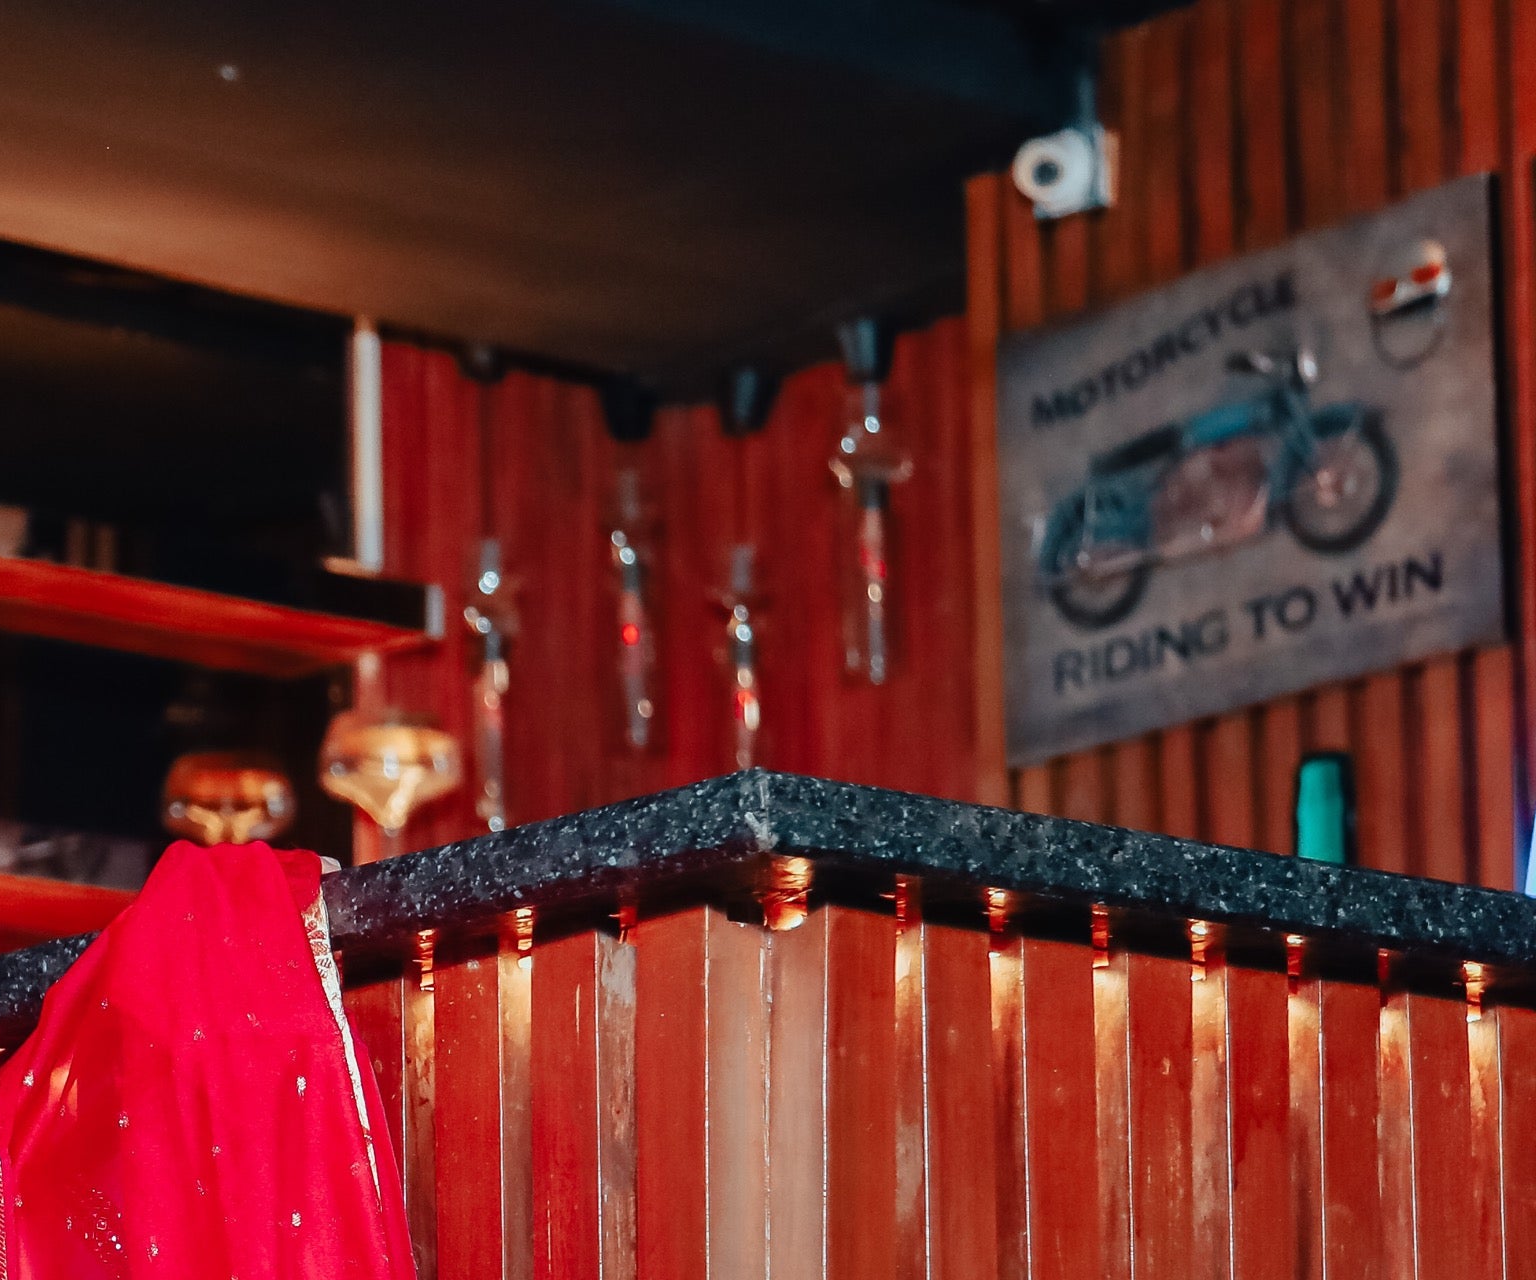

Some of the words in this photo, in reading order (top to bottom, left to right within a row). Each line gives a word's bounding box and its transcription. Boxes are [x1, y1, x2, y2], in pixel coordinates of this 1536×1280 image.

[1031, 270, 1298, 428] MOTORCYCLE
[1053, 612, 1228, 694] RIDING
[1244, 587, 1318, 642] TO
[1332, 550, 1444, 616] WIN
